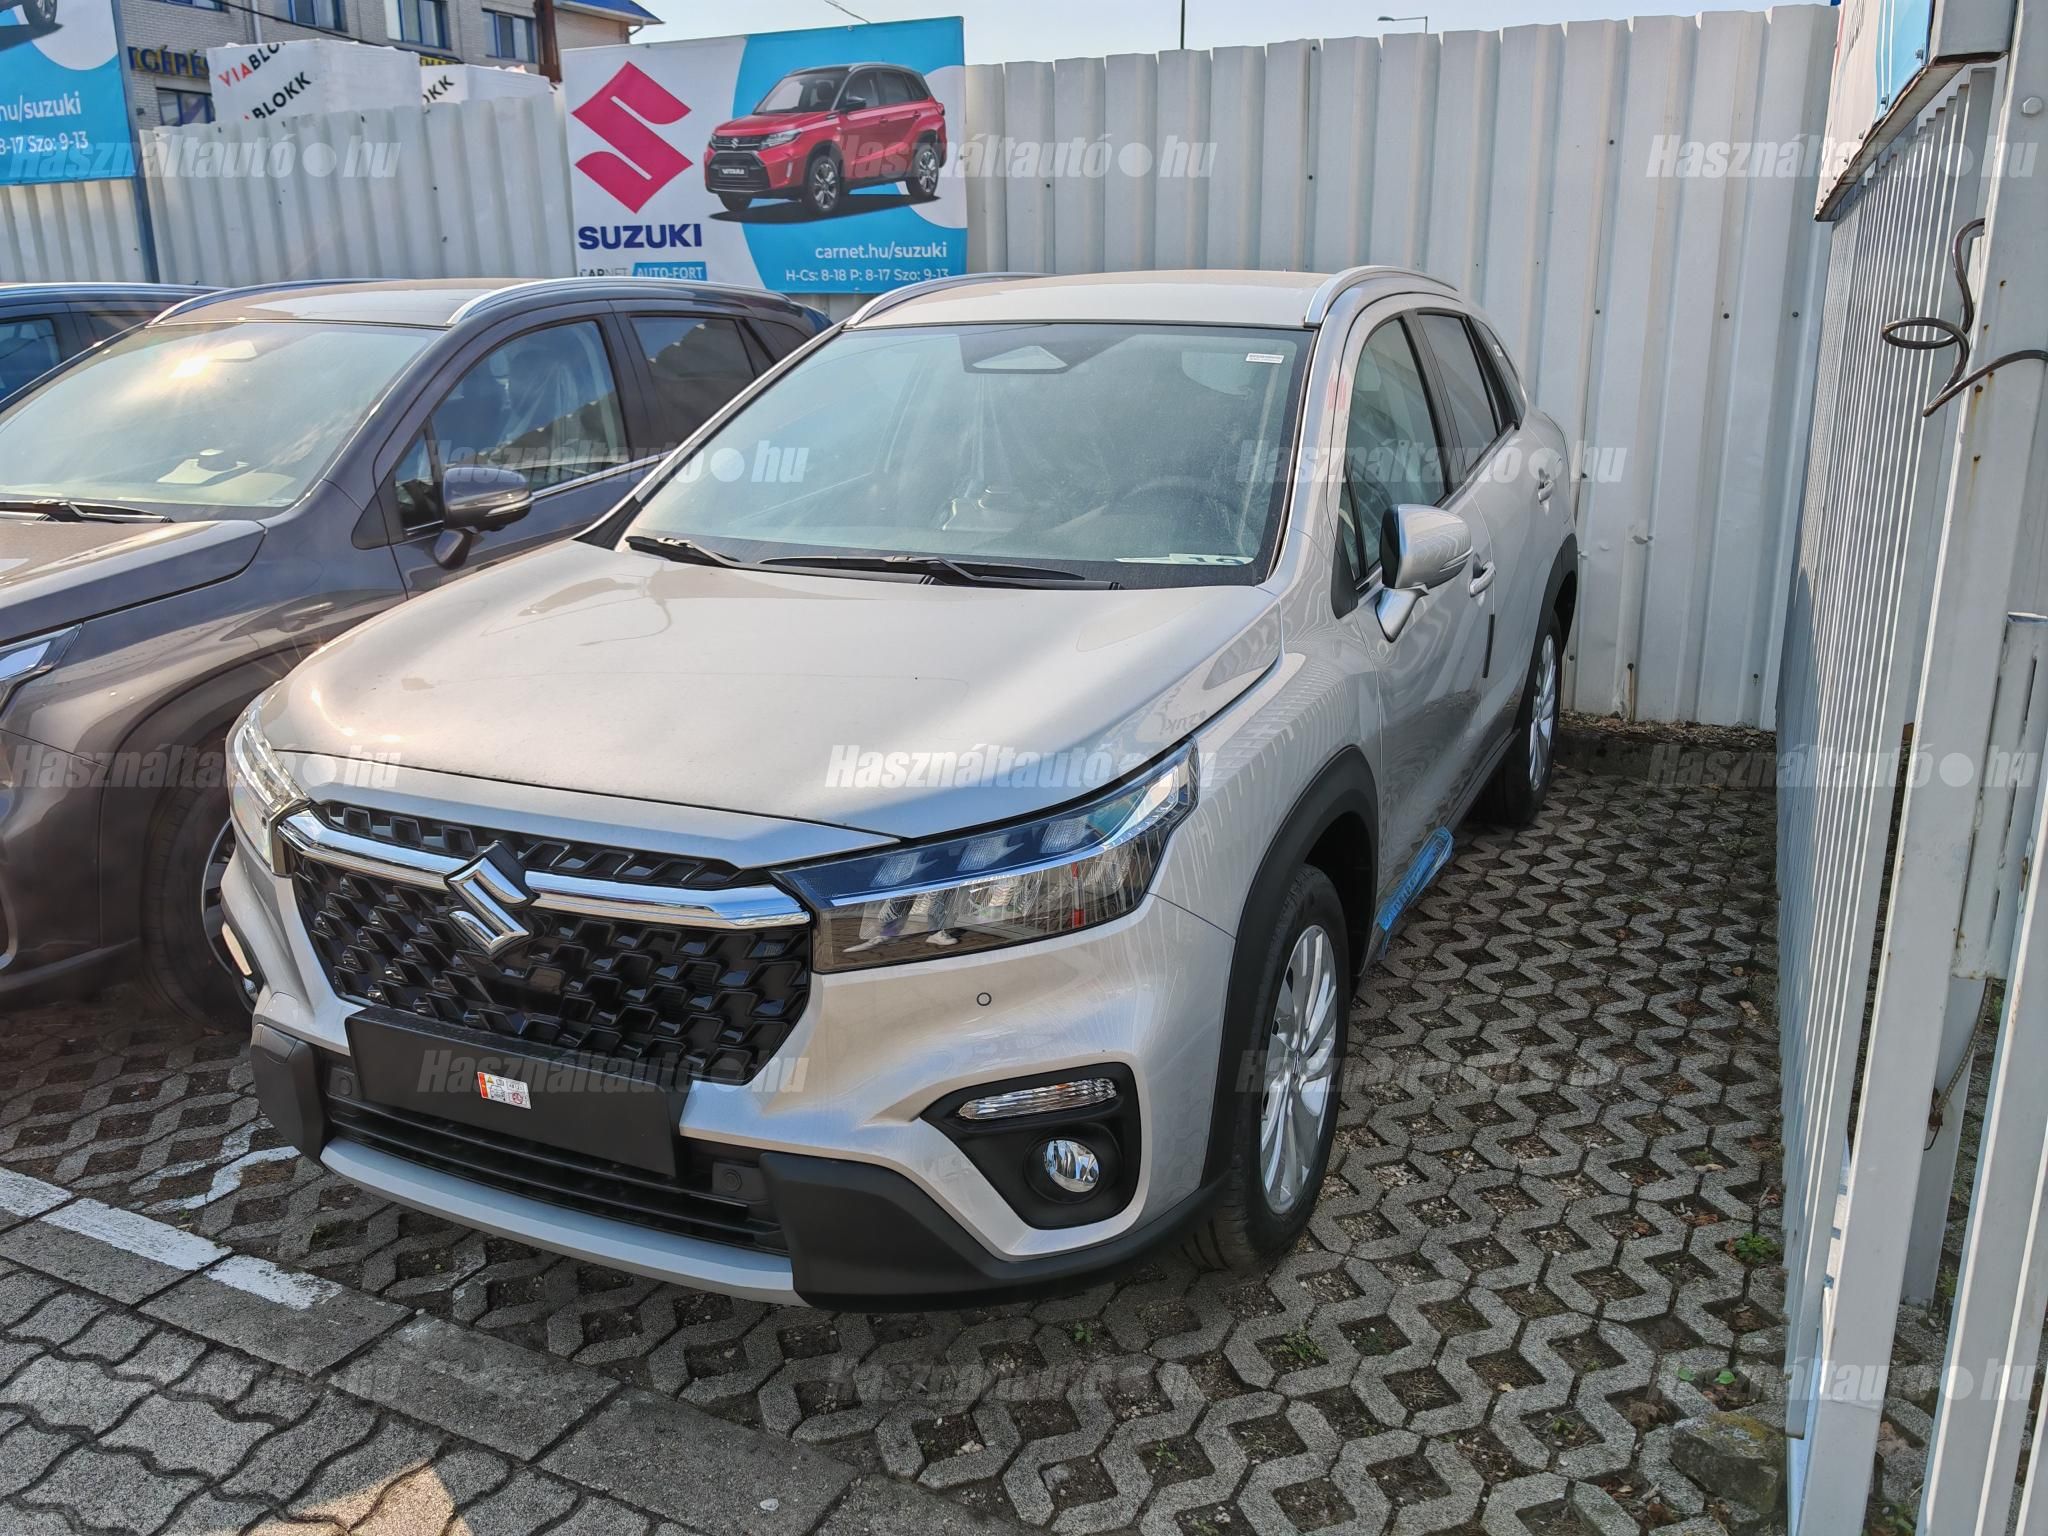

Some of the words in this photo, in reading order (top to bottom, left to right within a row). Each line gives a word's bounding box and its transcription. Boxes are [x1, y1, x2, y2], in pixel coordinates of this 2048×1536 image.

[218, 43, 286, 87] VIABLO
[244, 71, 312, 120] BLOKK
[27, 135, 57, 152] Szo:
[58, 131, 89, 150] 9-13
[578, 224, 703, 250] SUZUKI
[815, 241, 948, 260] carnet.hu/suzuki
[785, 270, 818, 282] H-Cs:
[821, 269, 847, 281] 8-18
[850, 269, 862, 281] P:
[865, 269, 891, 281] 8-17
[894, 268, 921, 281] Szo:
